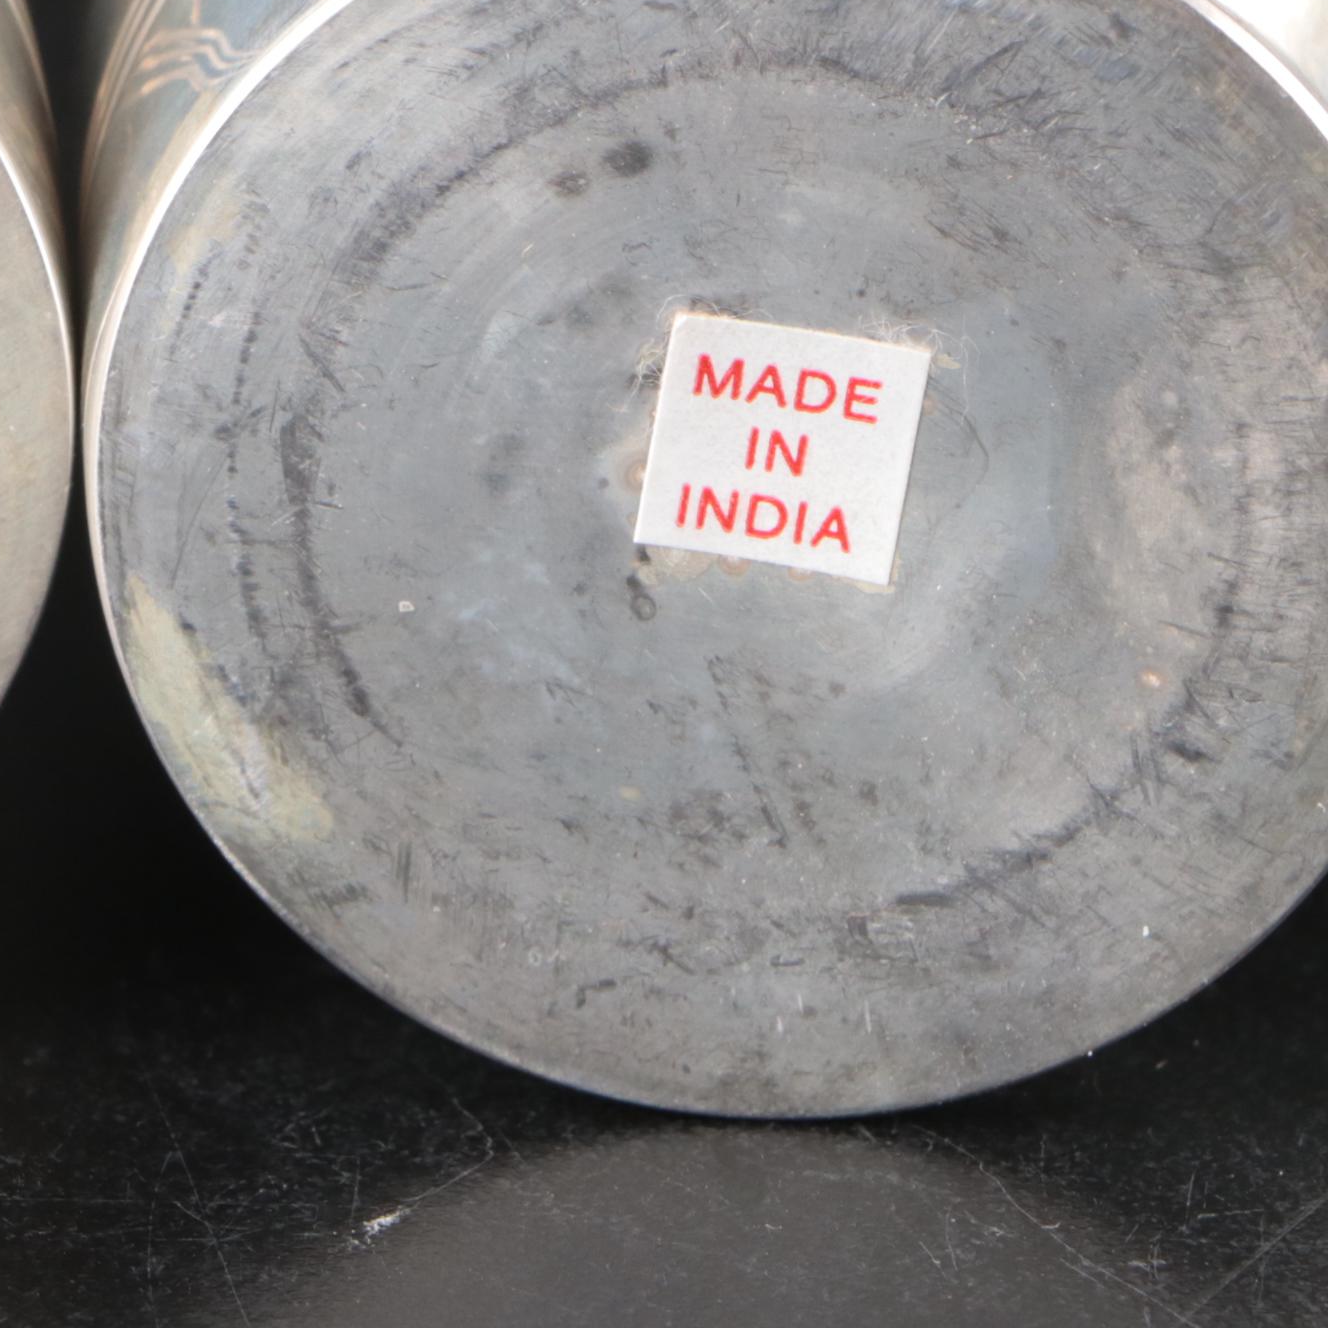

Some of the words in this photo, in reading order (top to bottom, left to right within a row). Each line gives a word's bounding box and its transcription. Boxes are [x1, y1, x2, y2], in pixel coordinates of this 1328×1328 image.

[692, 352, 884, 425] MADE
[744, 425, 810, 478] IN
[675, 482, 852, 554] INDIA
